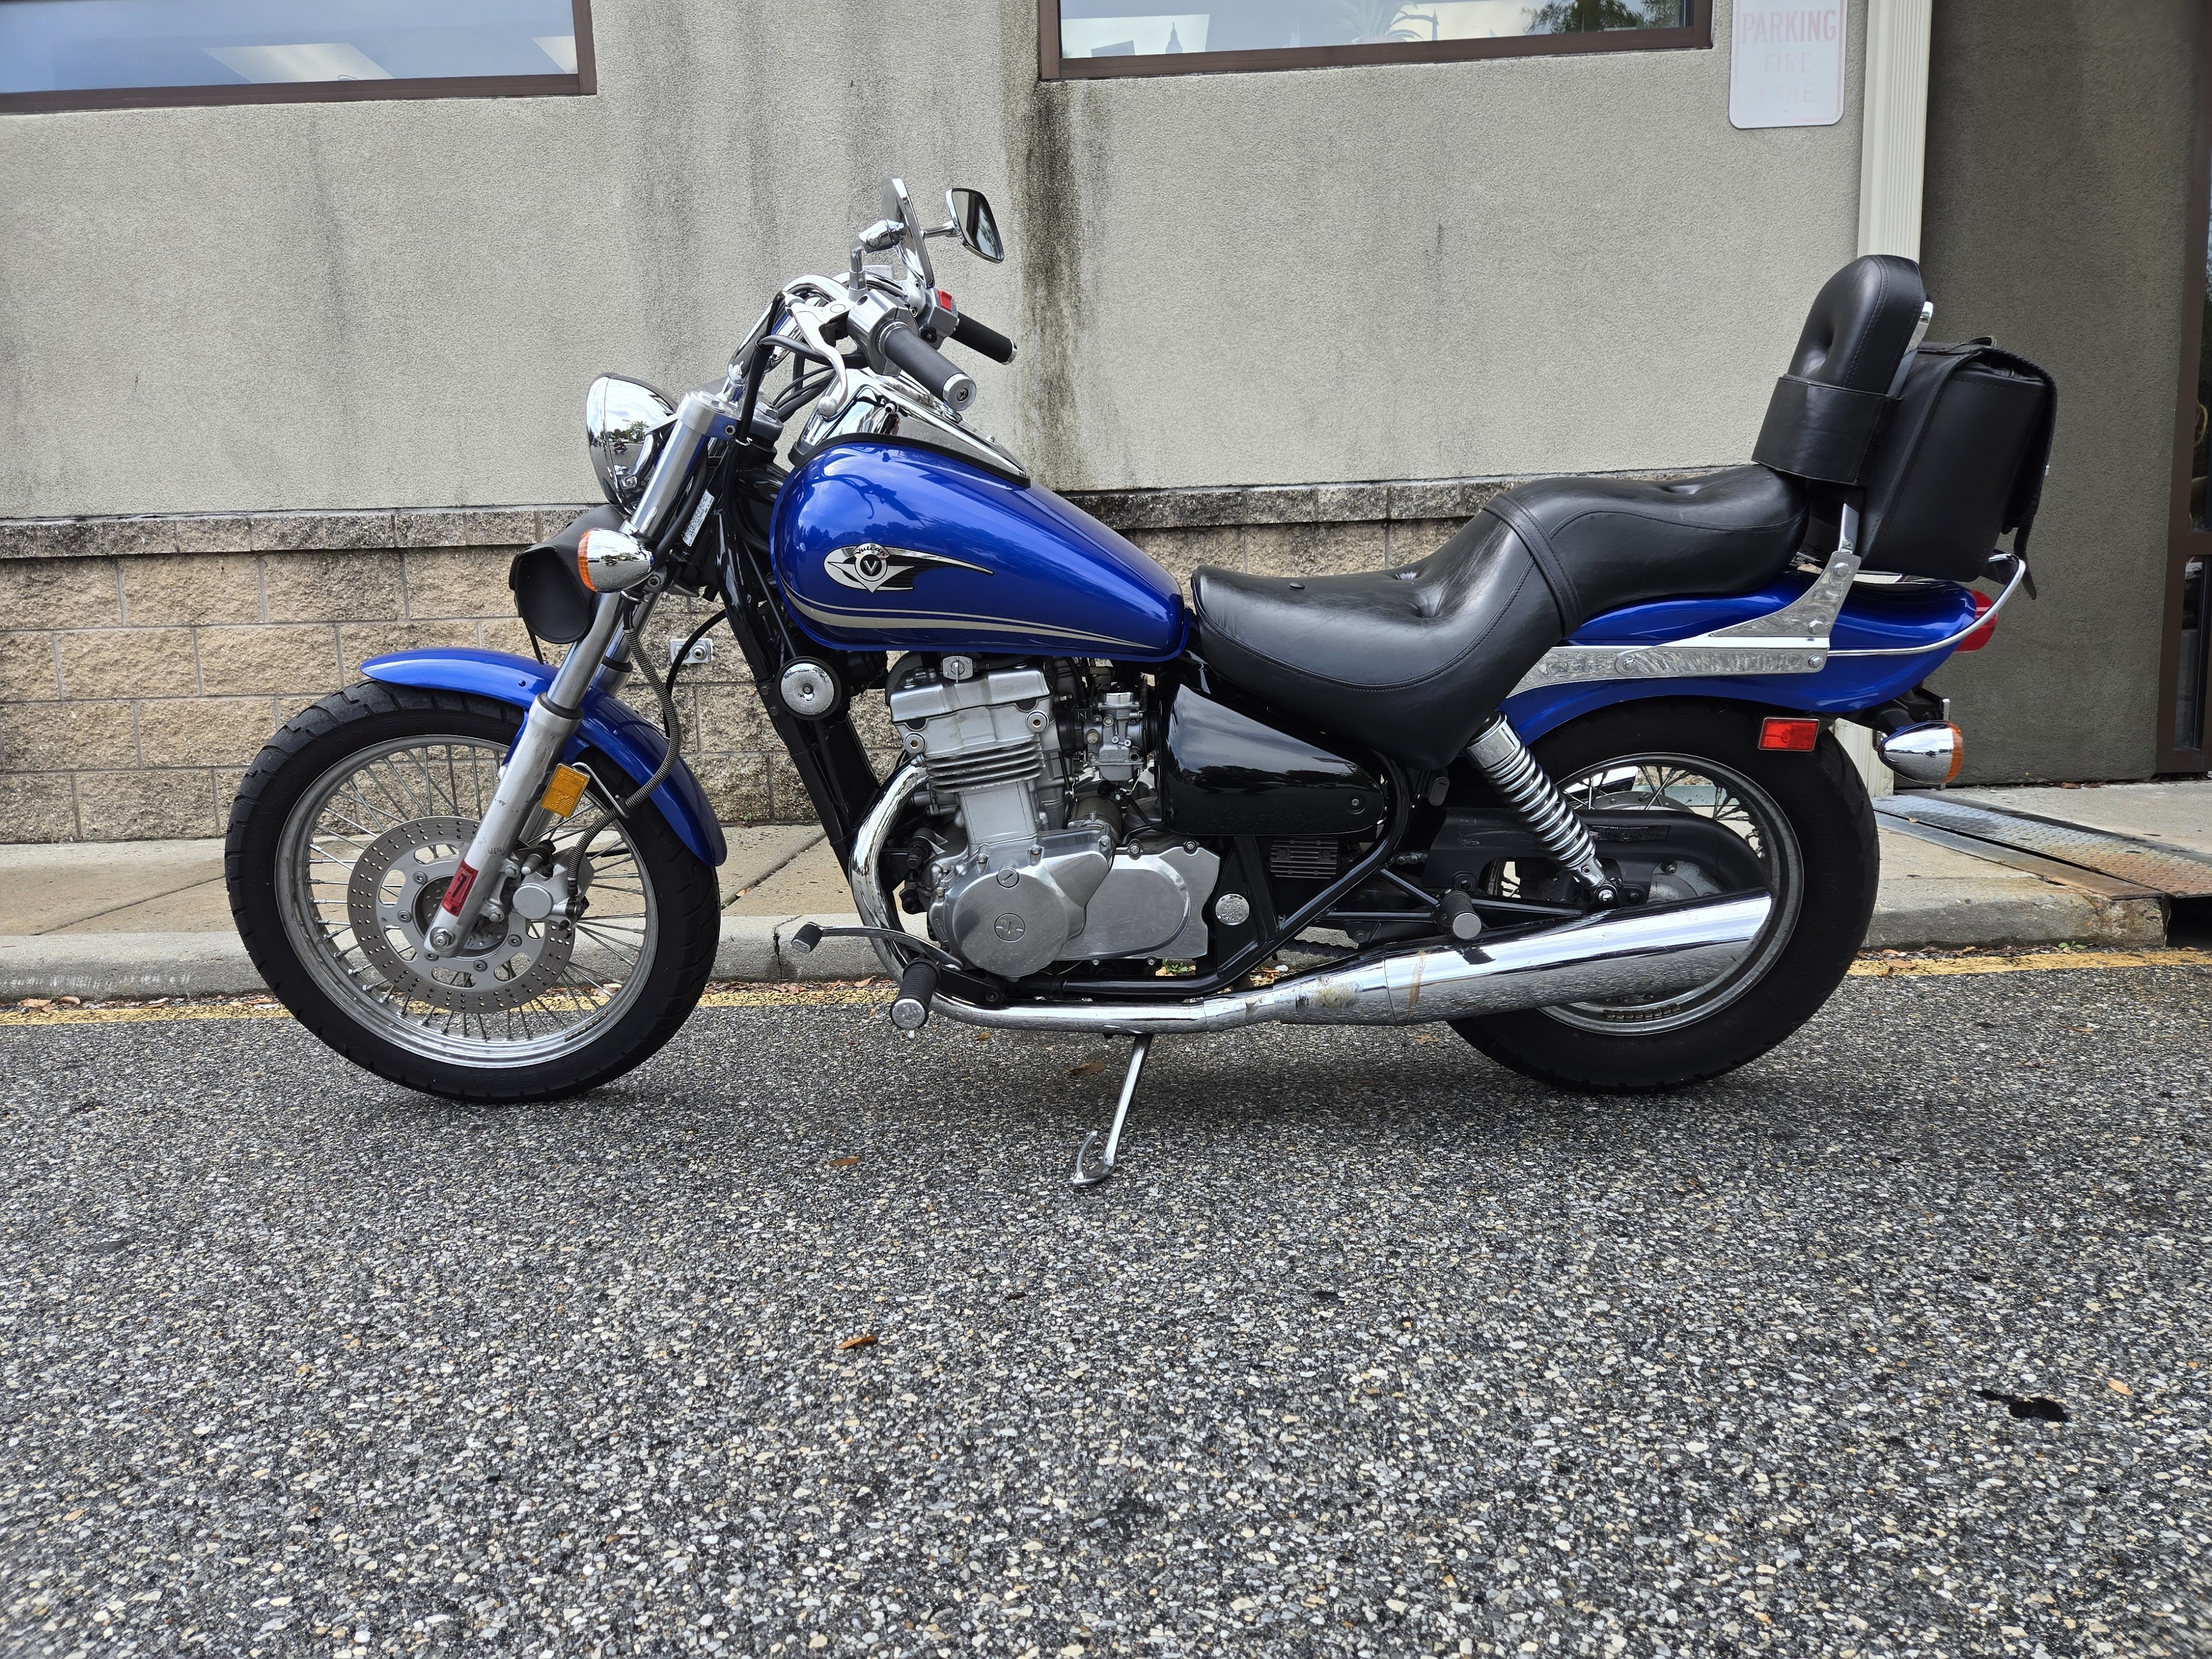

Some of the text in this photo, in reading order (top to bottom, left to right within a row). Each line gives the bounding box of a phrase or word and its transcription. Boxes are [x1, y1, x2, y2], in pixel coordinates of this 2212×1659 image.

[1742, 9, 1837, 43] PARKING
[1764, 52, 1812, 74] FIRE
[1760, 82, 1814, 105] LANE
[854, 546, 886, 556] Vulcan
[863, 560, 879, 575] V
